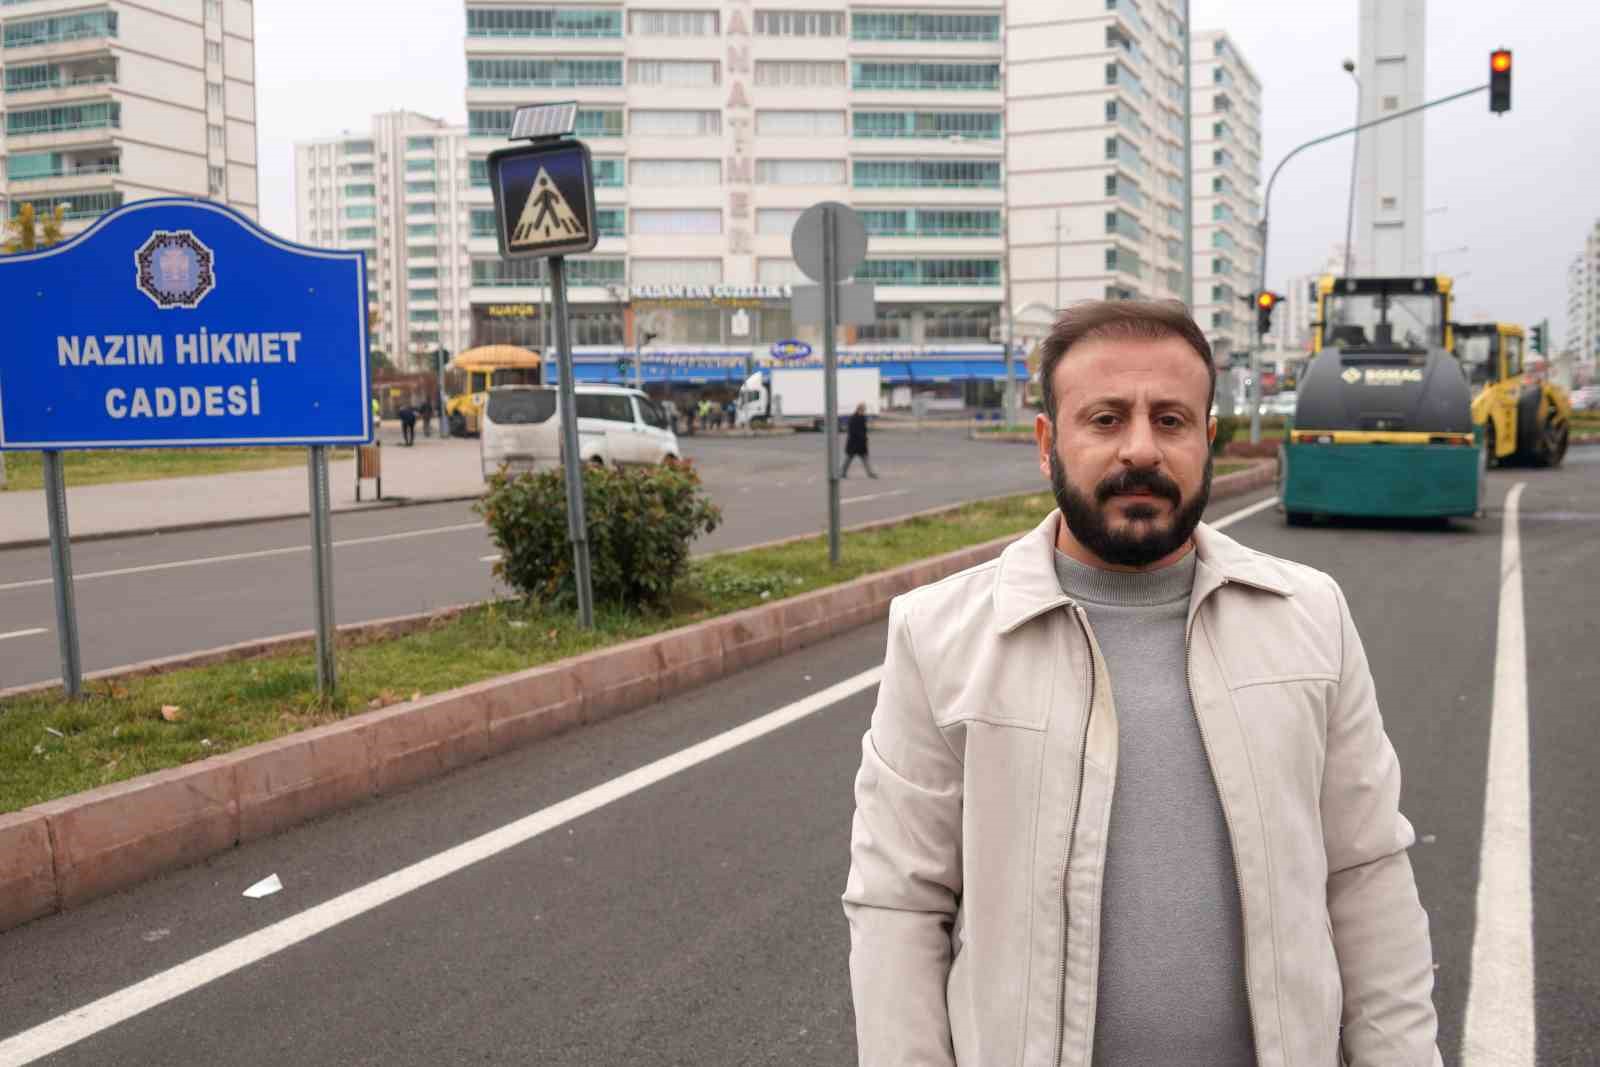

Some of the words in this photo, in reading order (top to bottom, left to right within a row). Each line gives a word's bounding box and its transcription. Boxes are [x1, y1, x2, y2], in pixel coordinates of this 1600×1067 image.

[57, 335, 164, 366] NAZIM
[176, 326, 301, 364] HİKMET
[105, 378, 260, 418] CADDESİ
